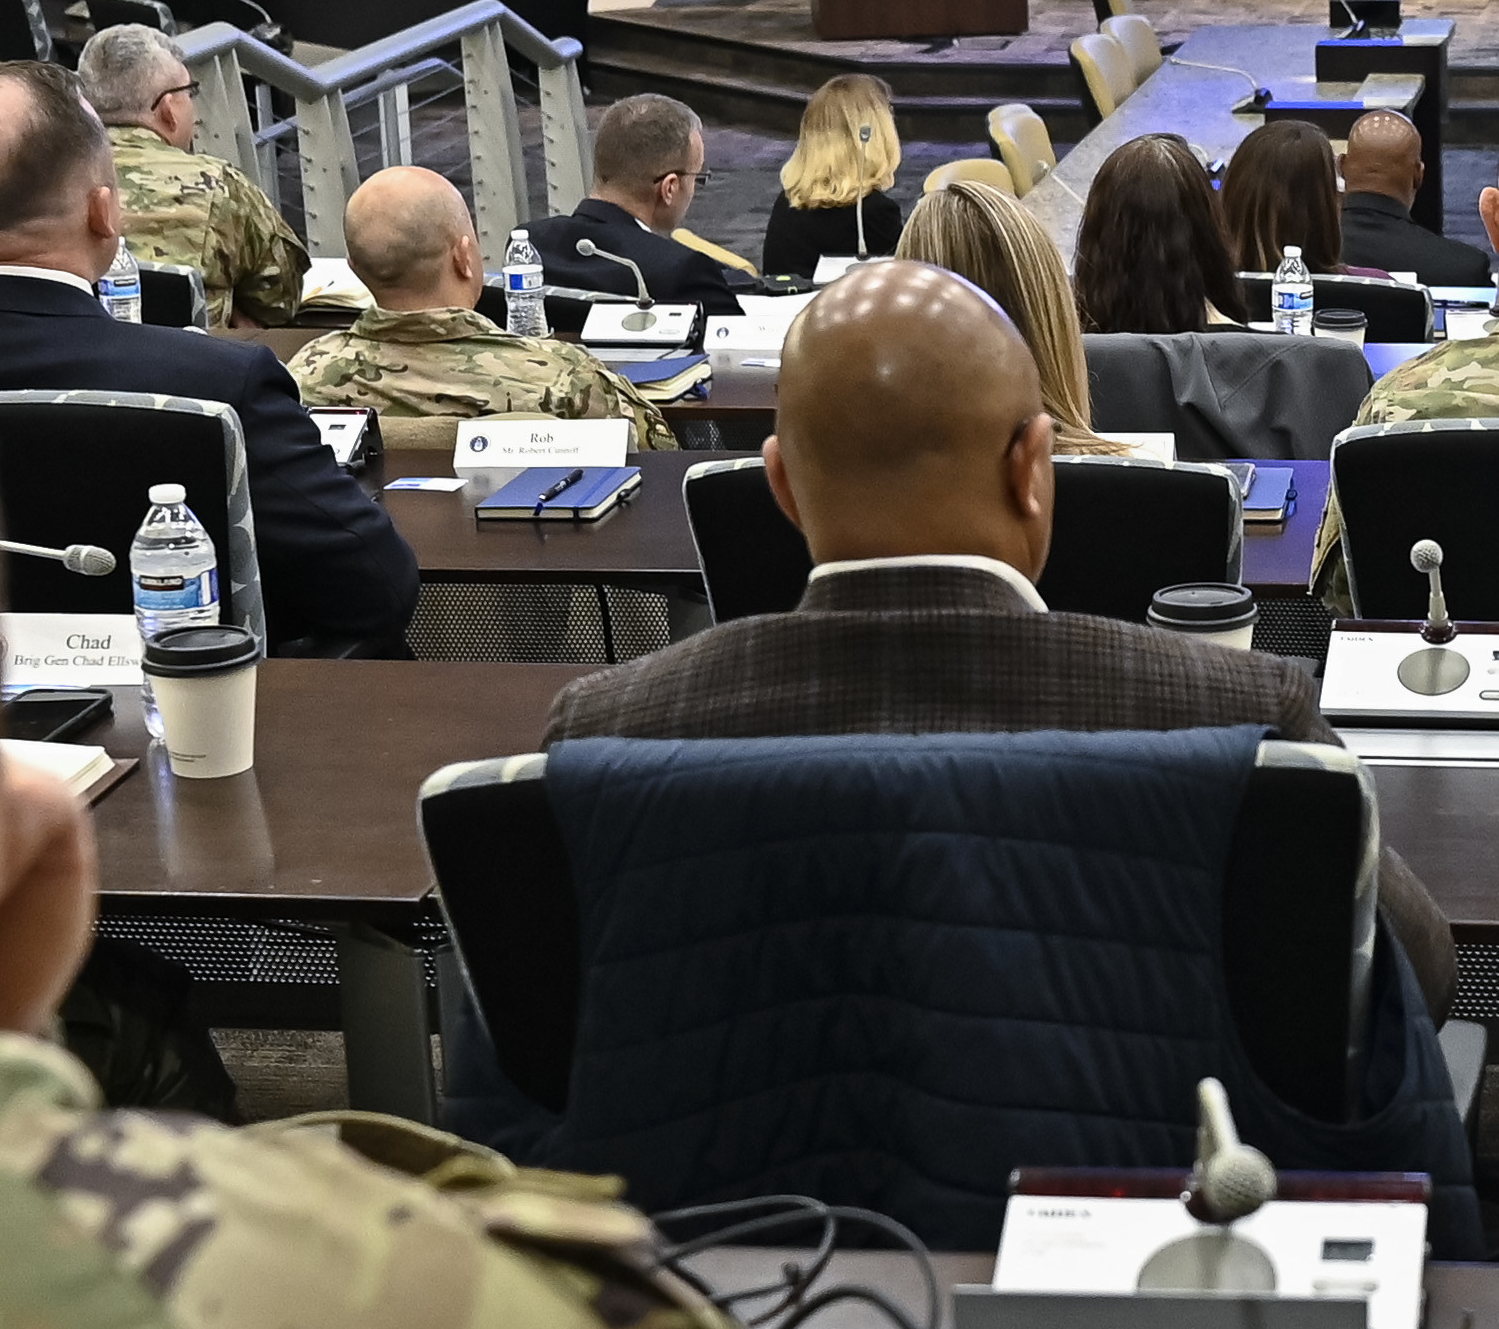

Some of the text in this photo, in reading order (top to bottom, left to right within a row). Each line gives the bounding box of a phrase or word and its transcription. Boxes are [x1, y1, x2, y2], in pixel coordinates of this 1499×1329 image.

[530, 433, 554, 443] Rob
[66, 633, 112, 650] Chad
[13, 654, 41, 669] Brig
[44, 654, 69, 667] Gen
[72, 654, 104, 667] Chad
